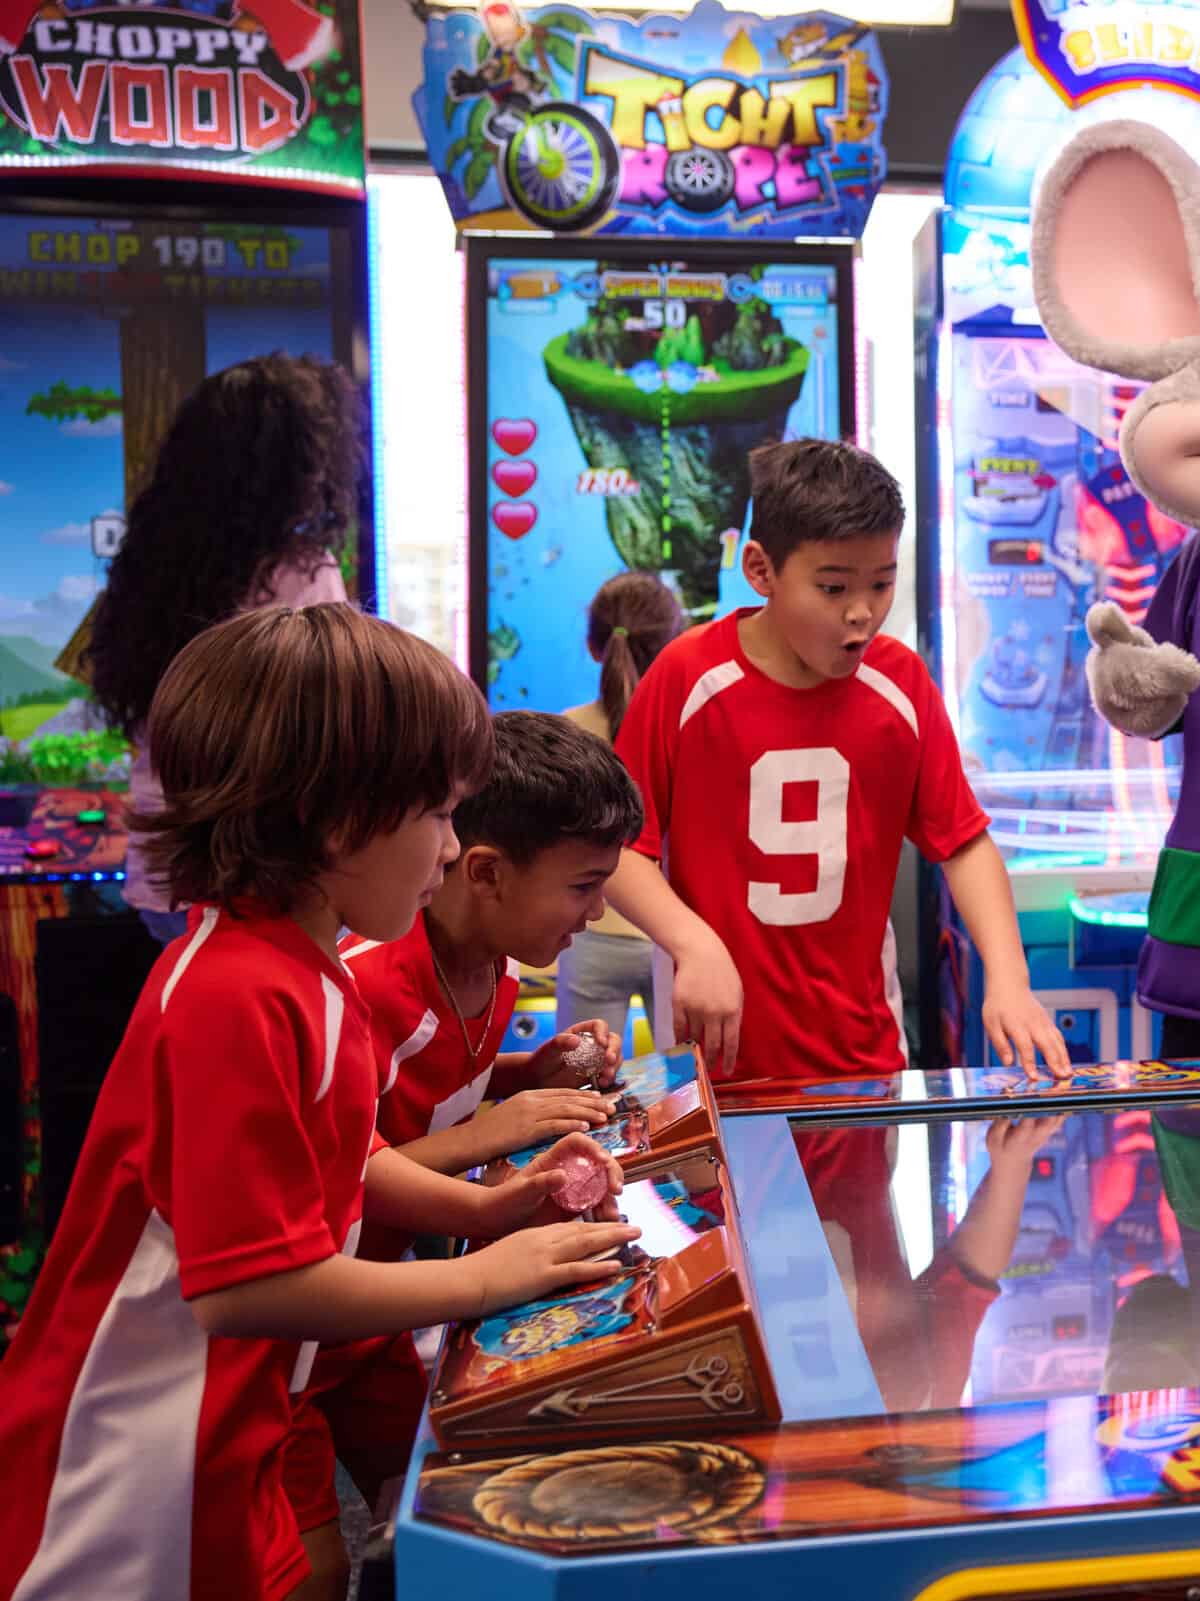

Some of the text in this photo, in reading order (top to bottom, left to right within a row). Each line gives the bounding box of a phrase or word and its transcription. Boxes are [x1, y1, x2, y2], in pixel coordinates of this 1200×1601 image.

[35, 19, 267, 65] CHOPPY
[9, 53, 303, 152] WOOD
[28, 231, 290, 270] CHOP 190 TO
[748, 747, 850, 927] 9
